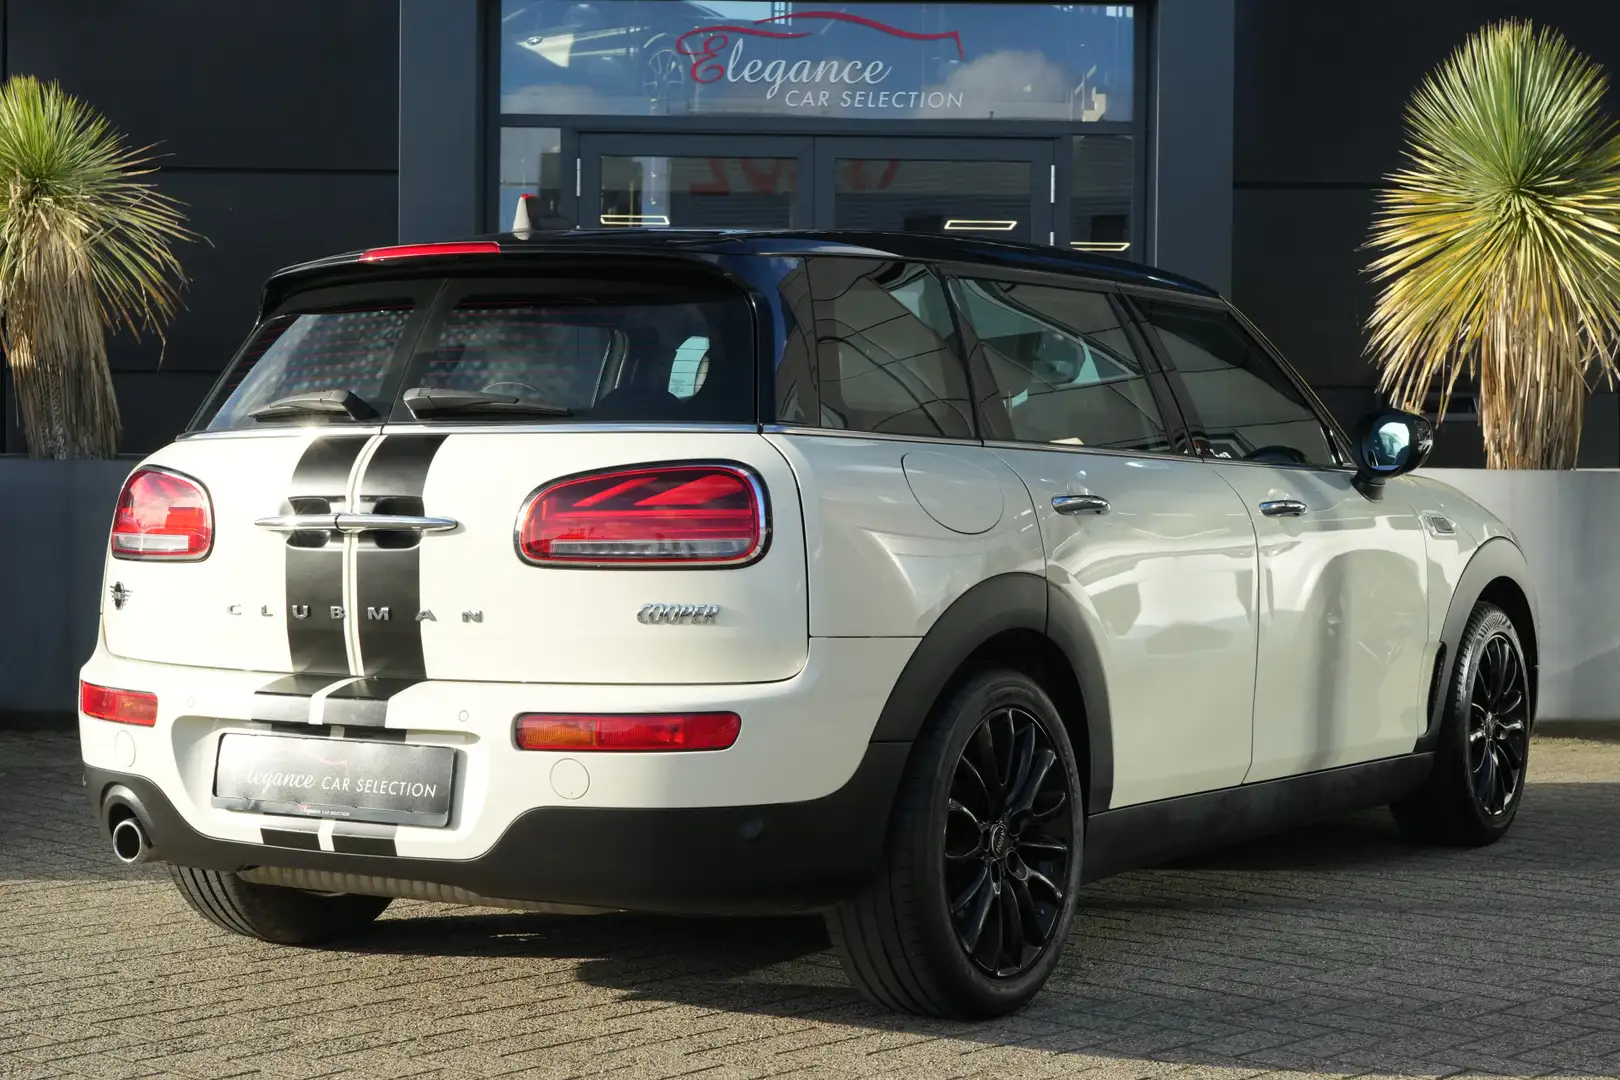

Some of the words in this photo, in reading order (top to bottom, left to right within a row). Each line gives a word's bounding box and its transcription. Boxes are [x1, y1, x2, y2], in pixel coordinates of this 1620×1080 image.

[688, 34, 892, 100] Elegance
[785, 90, 829, 108] CAR
[840, 91, 964, 109] SELECTION
[226, 604, 484, 624] CLUBMAN
[636, 603, 720, 625] COOPER
[321, 776, 350, 791] CAR
[356, 779, 437, 799] SELECTION
